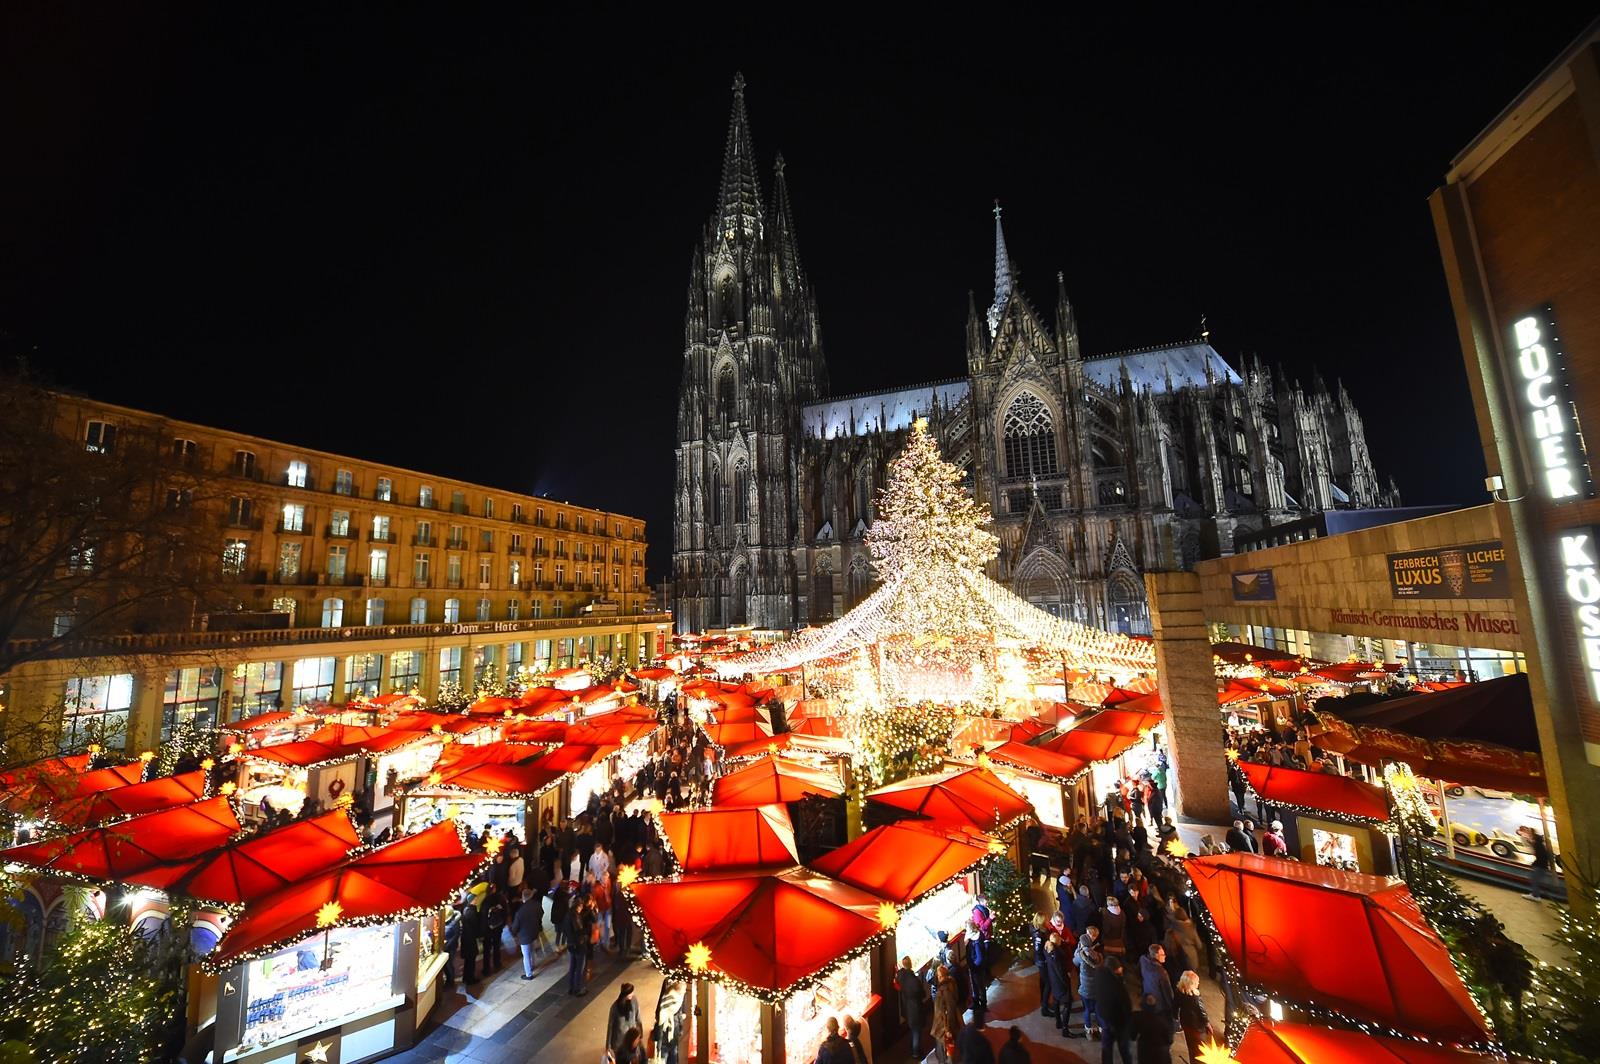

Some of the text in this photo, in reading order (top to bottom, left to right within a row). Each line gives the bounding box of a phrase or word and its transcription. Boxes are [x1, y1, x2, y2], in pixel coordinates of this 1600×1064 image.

[1513, 315, 1579, 500] BÜCHER
[1392, 556, 1439, 569] ZERBRECH
[1394, 569, 1442, 586] LUXUS
[452, 623, 479, 635] Dom
[1330, 609, 1459, 632] Römisch-Germanisches
